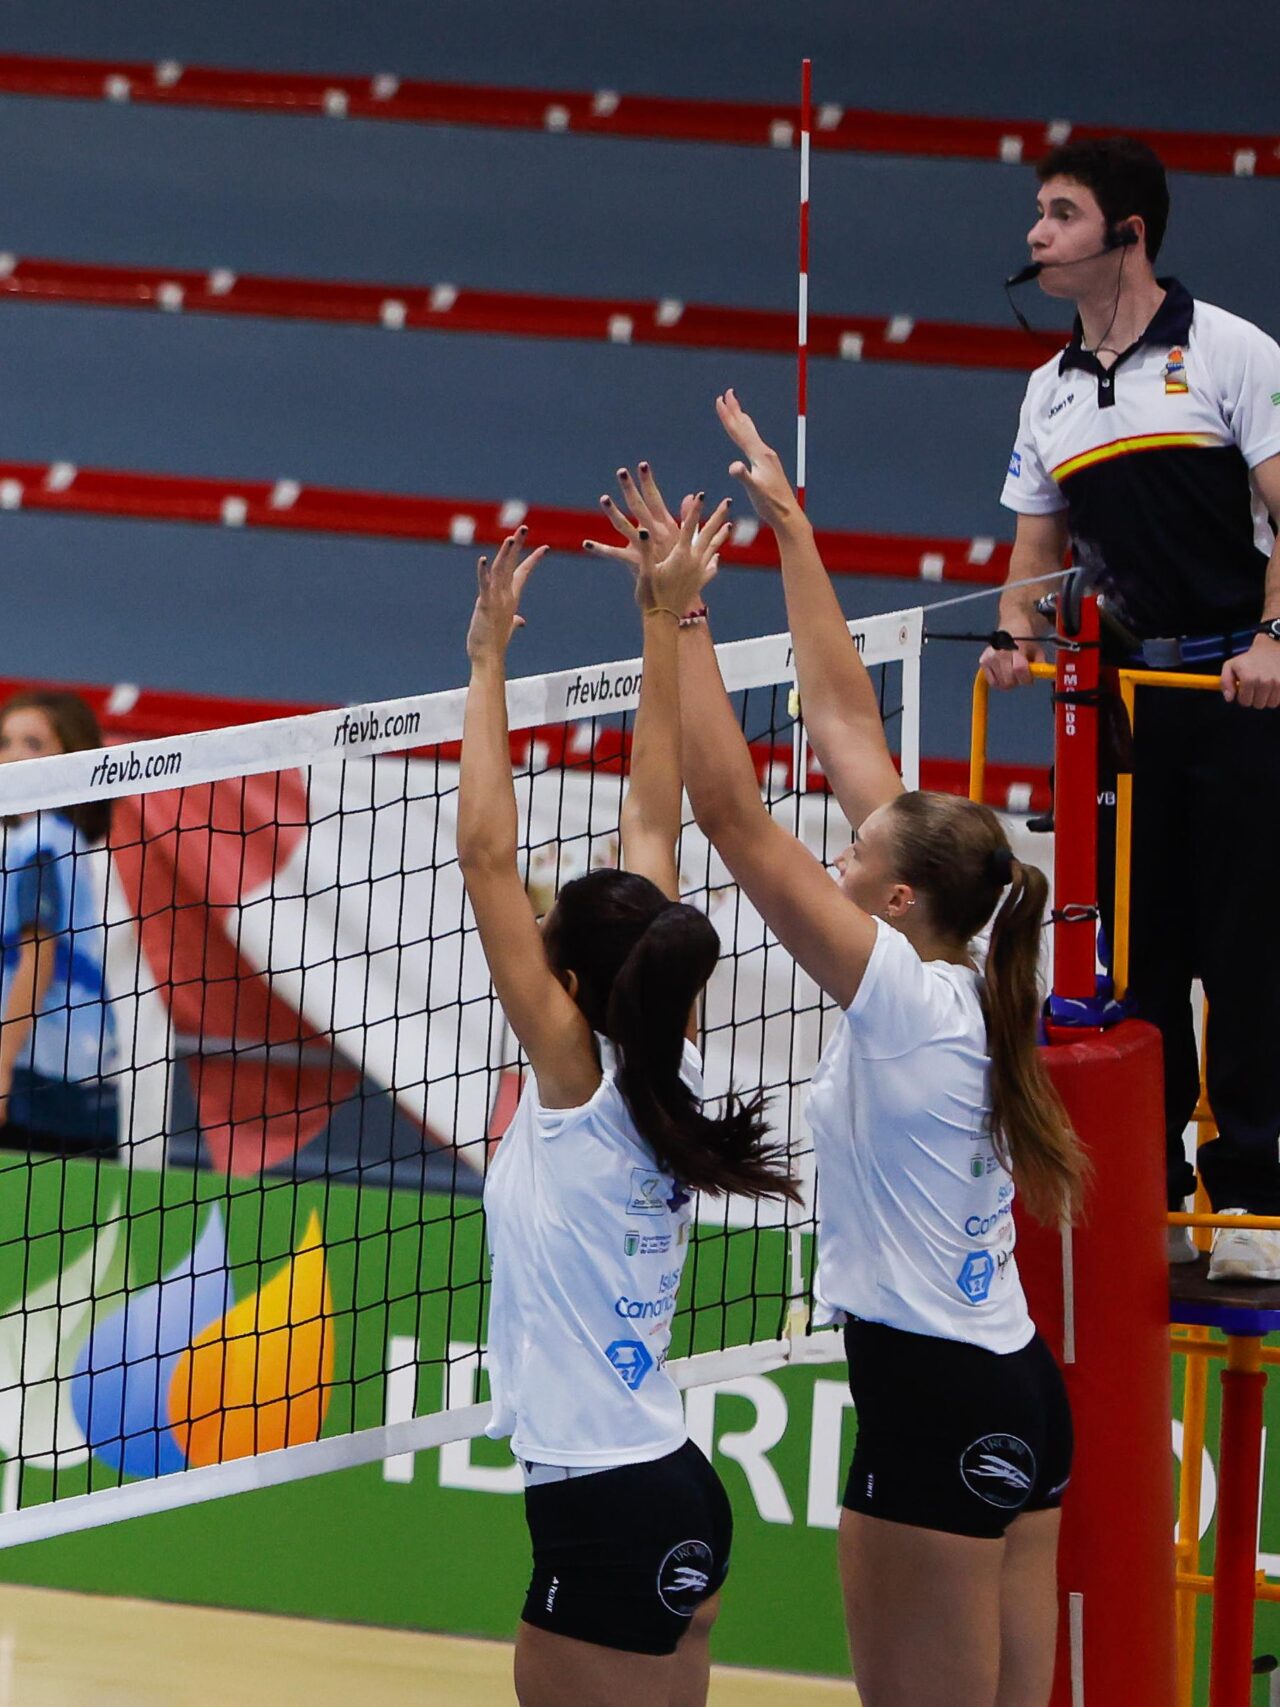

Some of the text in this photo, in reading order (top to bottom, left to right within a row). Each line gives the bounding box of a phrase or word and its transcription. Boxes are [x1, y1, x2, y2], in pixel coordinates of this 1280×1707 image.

[1063, 674, 1078, 737] MNDO
[333, 710, 421, 747] rfevb.com
[89, 749, 183, 787] rfevb.com
